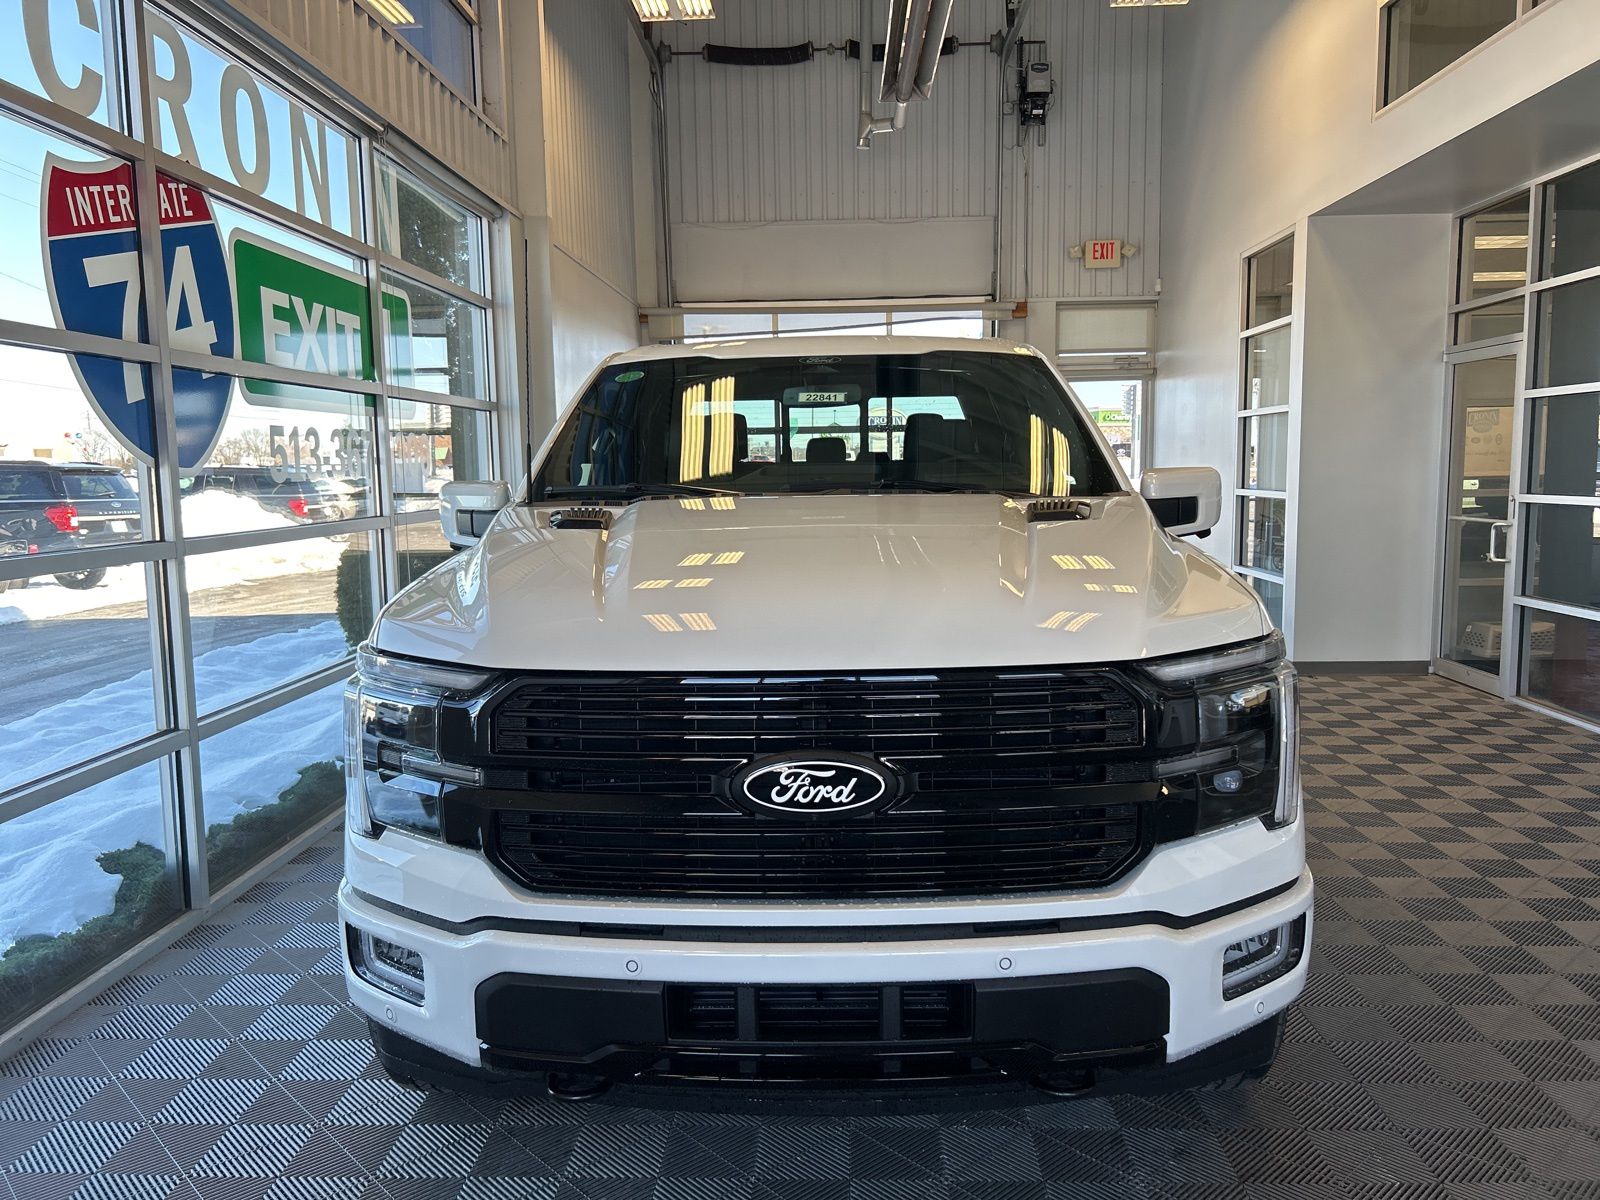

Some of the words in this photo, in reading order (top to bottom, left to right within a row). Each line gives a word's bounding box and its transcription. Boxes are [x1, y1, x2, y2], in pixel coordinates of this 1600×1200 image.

[65, 183, 193, 226] INTERATE
[1092, 242, 1115, 260] EXIT
[82, 245, 218, 404] 74
[260, 285, 362, 381] EXIT
[806, 394, 838, 402] 22841
[869, 416, 902, 426] CROIN
[770, 768, 858, 803] Ford
